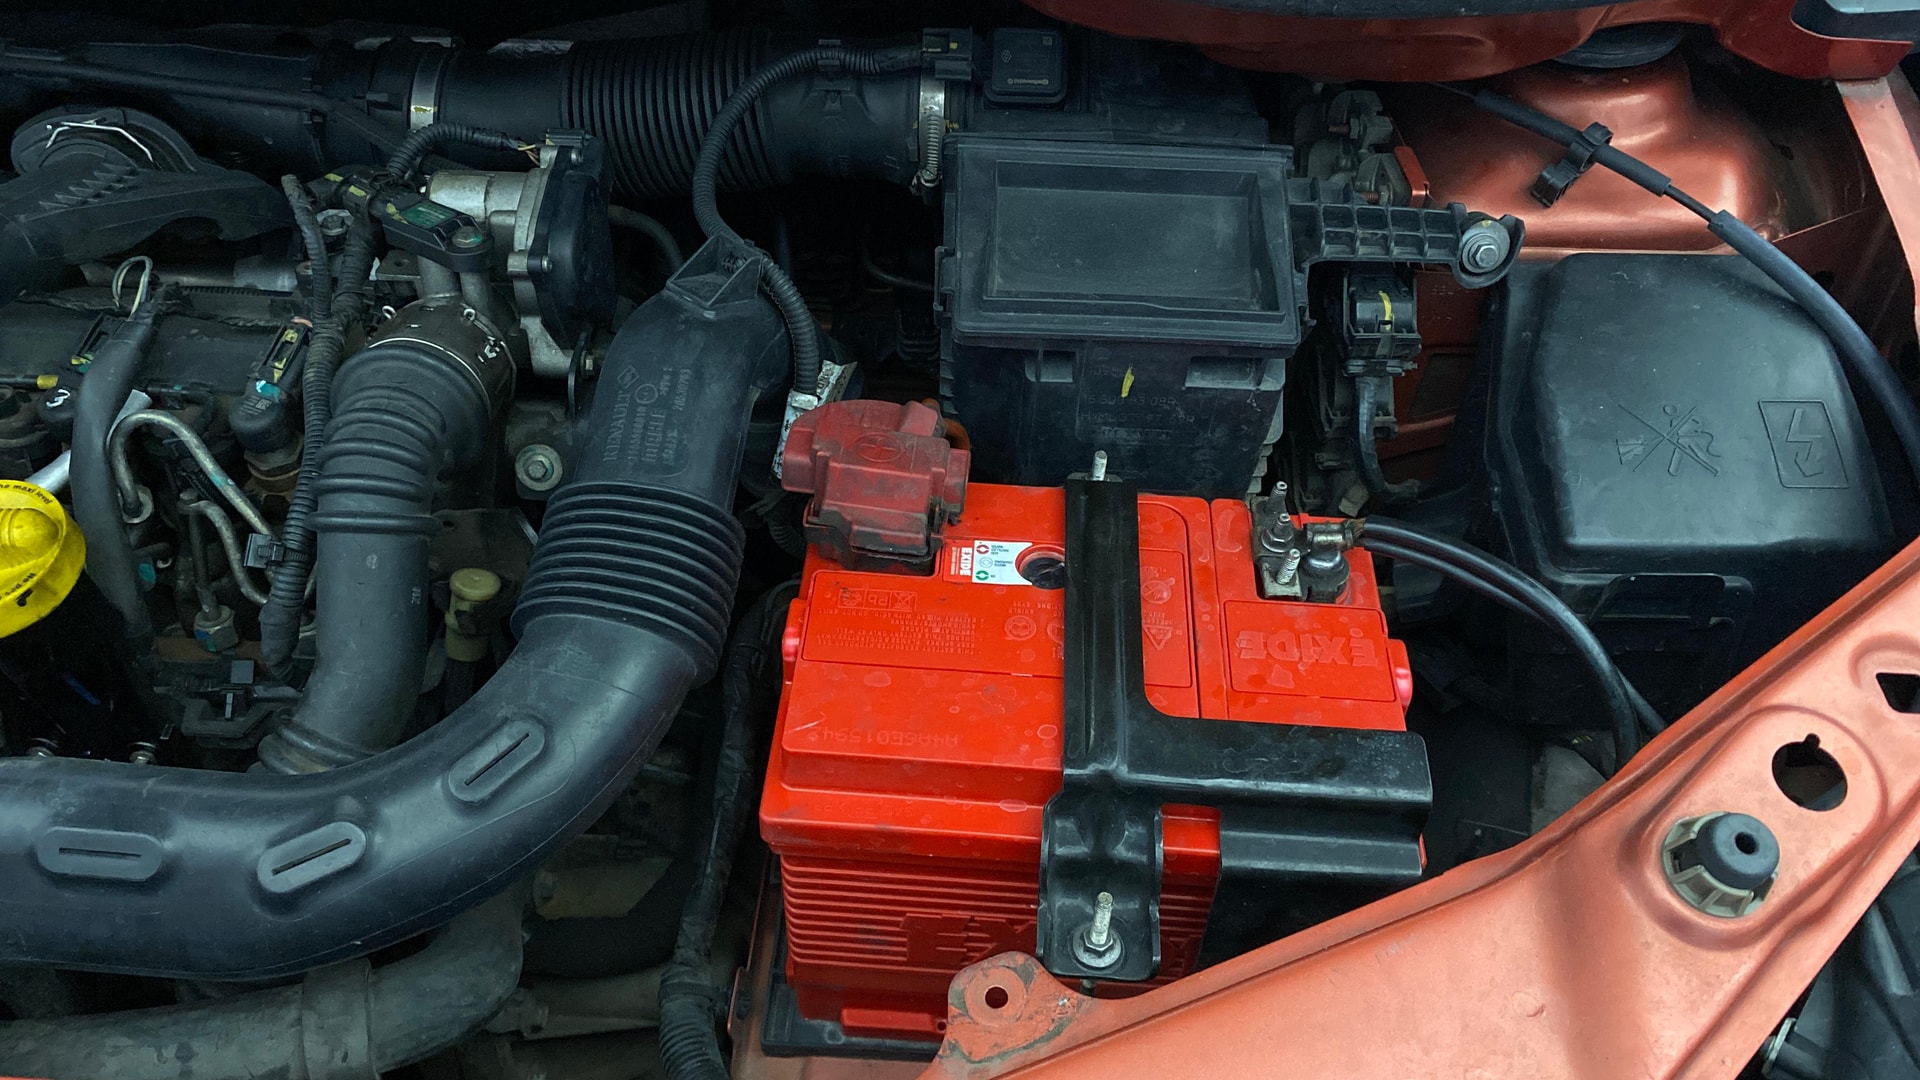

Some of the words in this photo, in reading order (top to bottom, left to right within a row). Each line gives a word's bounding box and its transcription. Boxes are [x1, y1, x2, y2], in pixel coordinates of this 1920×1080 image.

[602, 390, 630, 461] RENAULT
[12, 484, 36, 494] maxi
[35, 490, 54, 505] level
[960, 547, 973, 576] EXIDE
[868, 595, 887, 605] Pb
[1235, 630, 1379, 668] EXIDE
